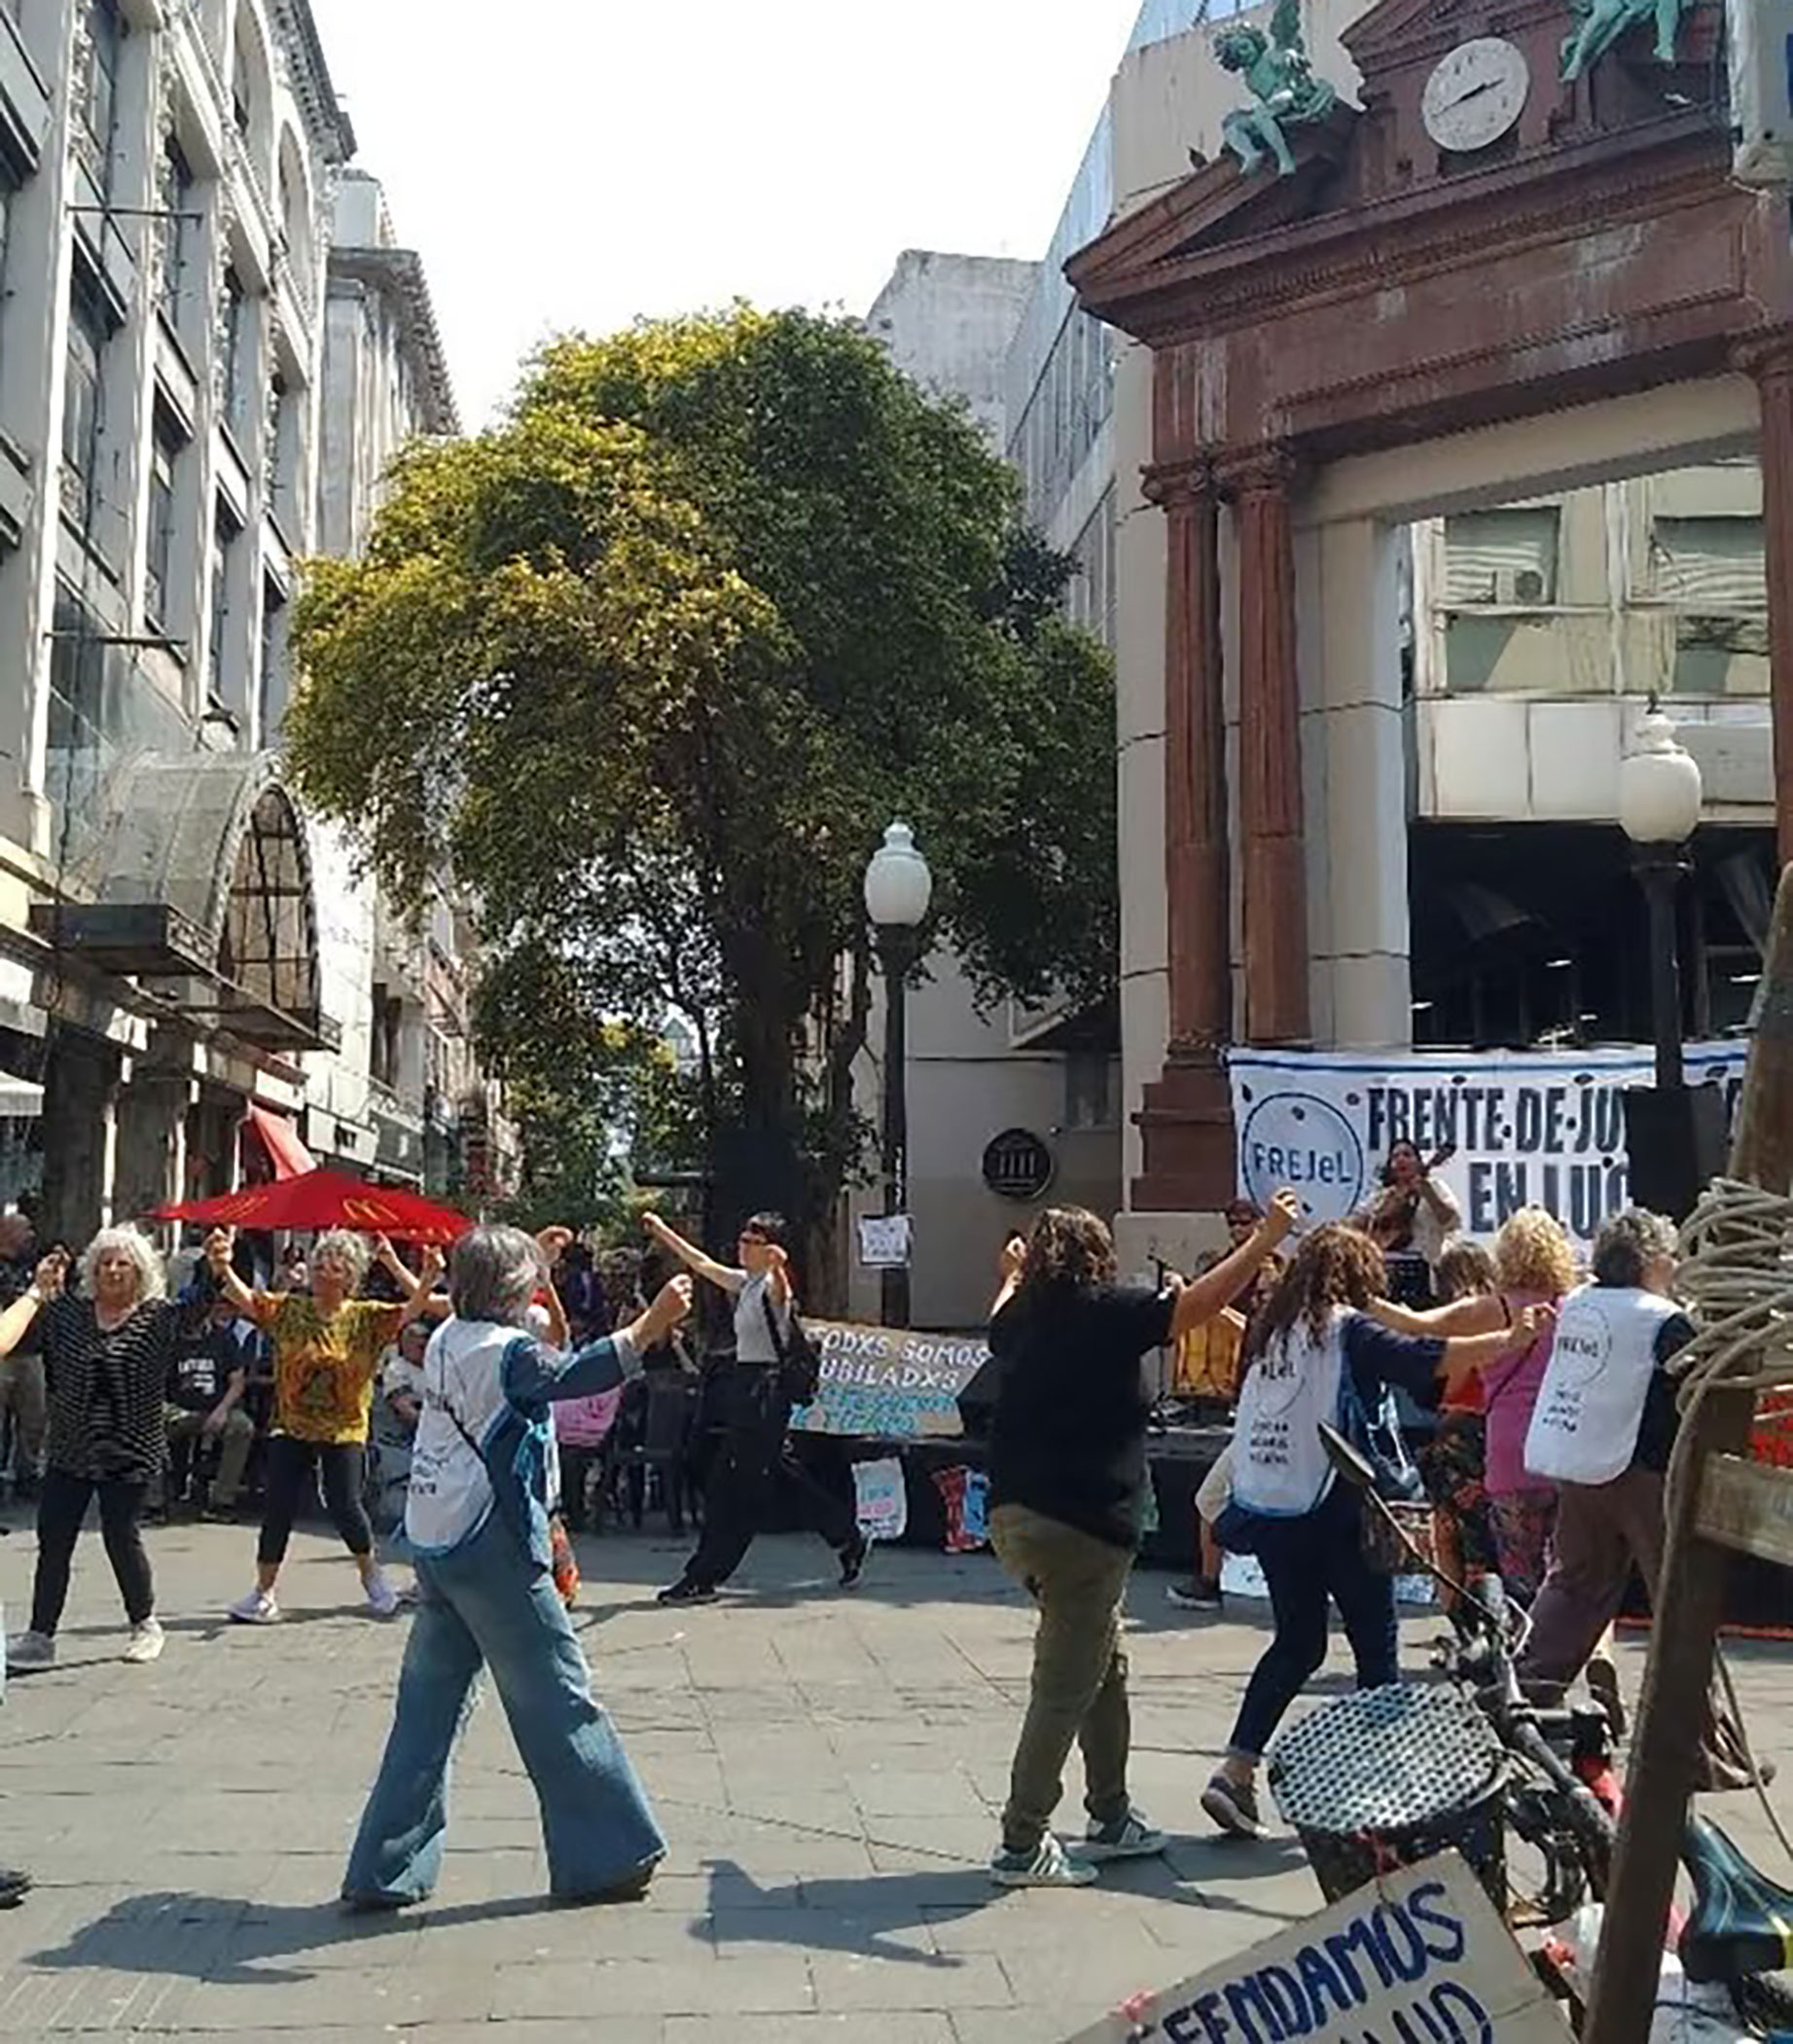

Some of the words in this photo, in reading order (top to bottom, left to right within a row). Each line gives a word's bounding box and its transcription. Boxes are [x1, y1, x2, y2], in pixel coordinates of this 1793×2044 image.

[1367, 1088, 1504, 1152] FRENTE
[1515, 1088, 1565, 1154] DE
[1572, 1088, 1626, 1154] JU
[1469, 1163, 1528, 1233] EN
[817, 1359, 960, 1391] UBILADXS
